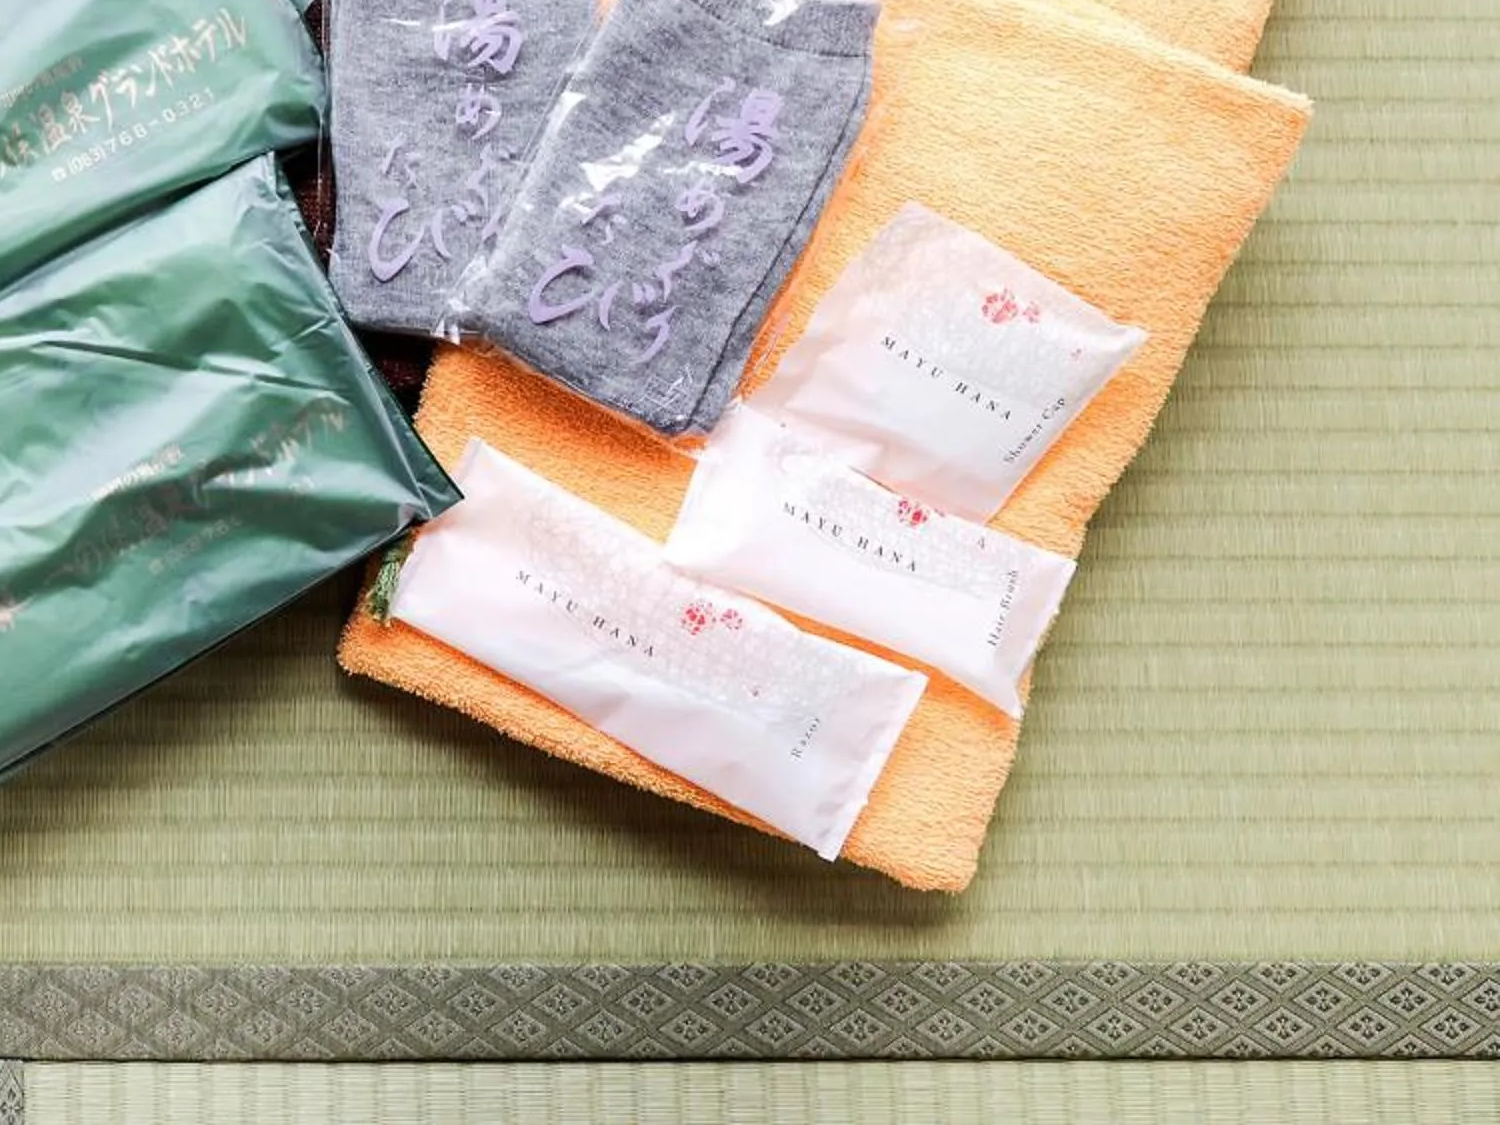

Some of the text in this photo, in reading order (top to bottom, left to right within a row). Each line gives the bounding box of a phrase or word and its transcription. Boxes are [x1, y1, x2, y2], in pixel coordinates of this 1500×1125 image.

[882, 336, 1013, 420] MAYU HANA
[1003, 397, 1067, 463] Shower Cap
[783, 502, 917, 572] MAYU HANA
[515, 570, 656, 658] MAYU HANA
[790, 716, 821, 759] Razor
